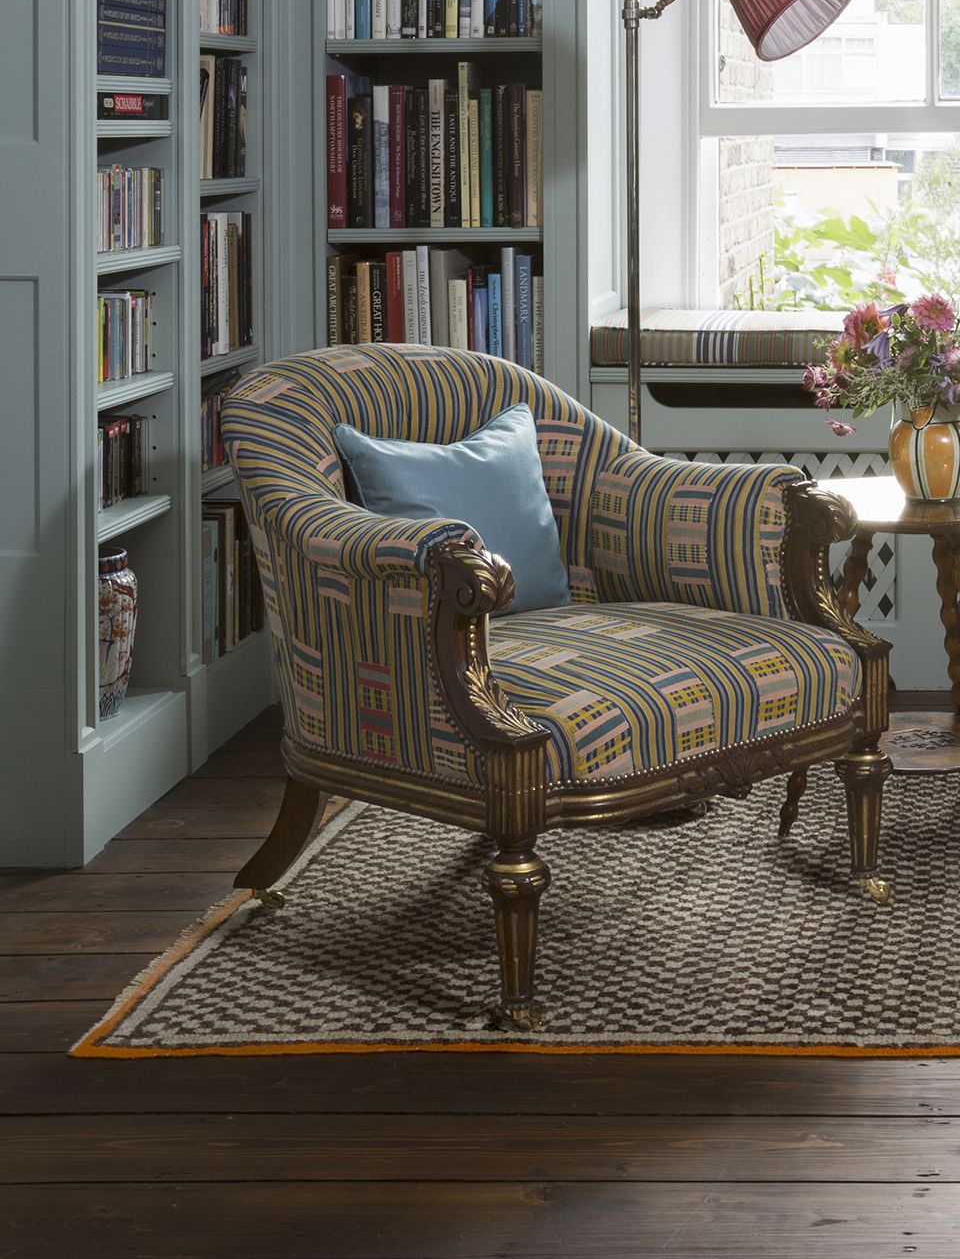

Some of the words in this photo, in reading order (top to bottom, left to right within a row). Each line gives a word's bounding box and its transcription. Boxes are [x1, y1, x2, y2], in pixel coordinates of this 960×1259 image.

[431, 109, 441, 130] THE
[449, 112, 457, 134] TASTE
[431, 133, 441, 180] ENGLISH
[449, 134, 457, 154] AND
[470, 137, 478, 172] SCOTLAND
[336, 164, 342, 173] OF
[449, 154, 457, 168] THE
[431, 180, 441, 214] TOWN
[449, 169, 457, 204] ANTIQUE
[328, 265, 337, 293] GREAT
[406, 284, 414, 305] IRISH
[519, 266, 529, 323] LANDMARK
[372, 290, 382, 322] GREAT
[420, 285, 428, 306] Irish
[360, 294, 368, 335] ANCESTRAL
[420, 307, 428, 340] COUNTRY
[491, 302, 499, 339] Christopher
